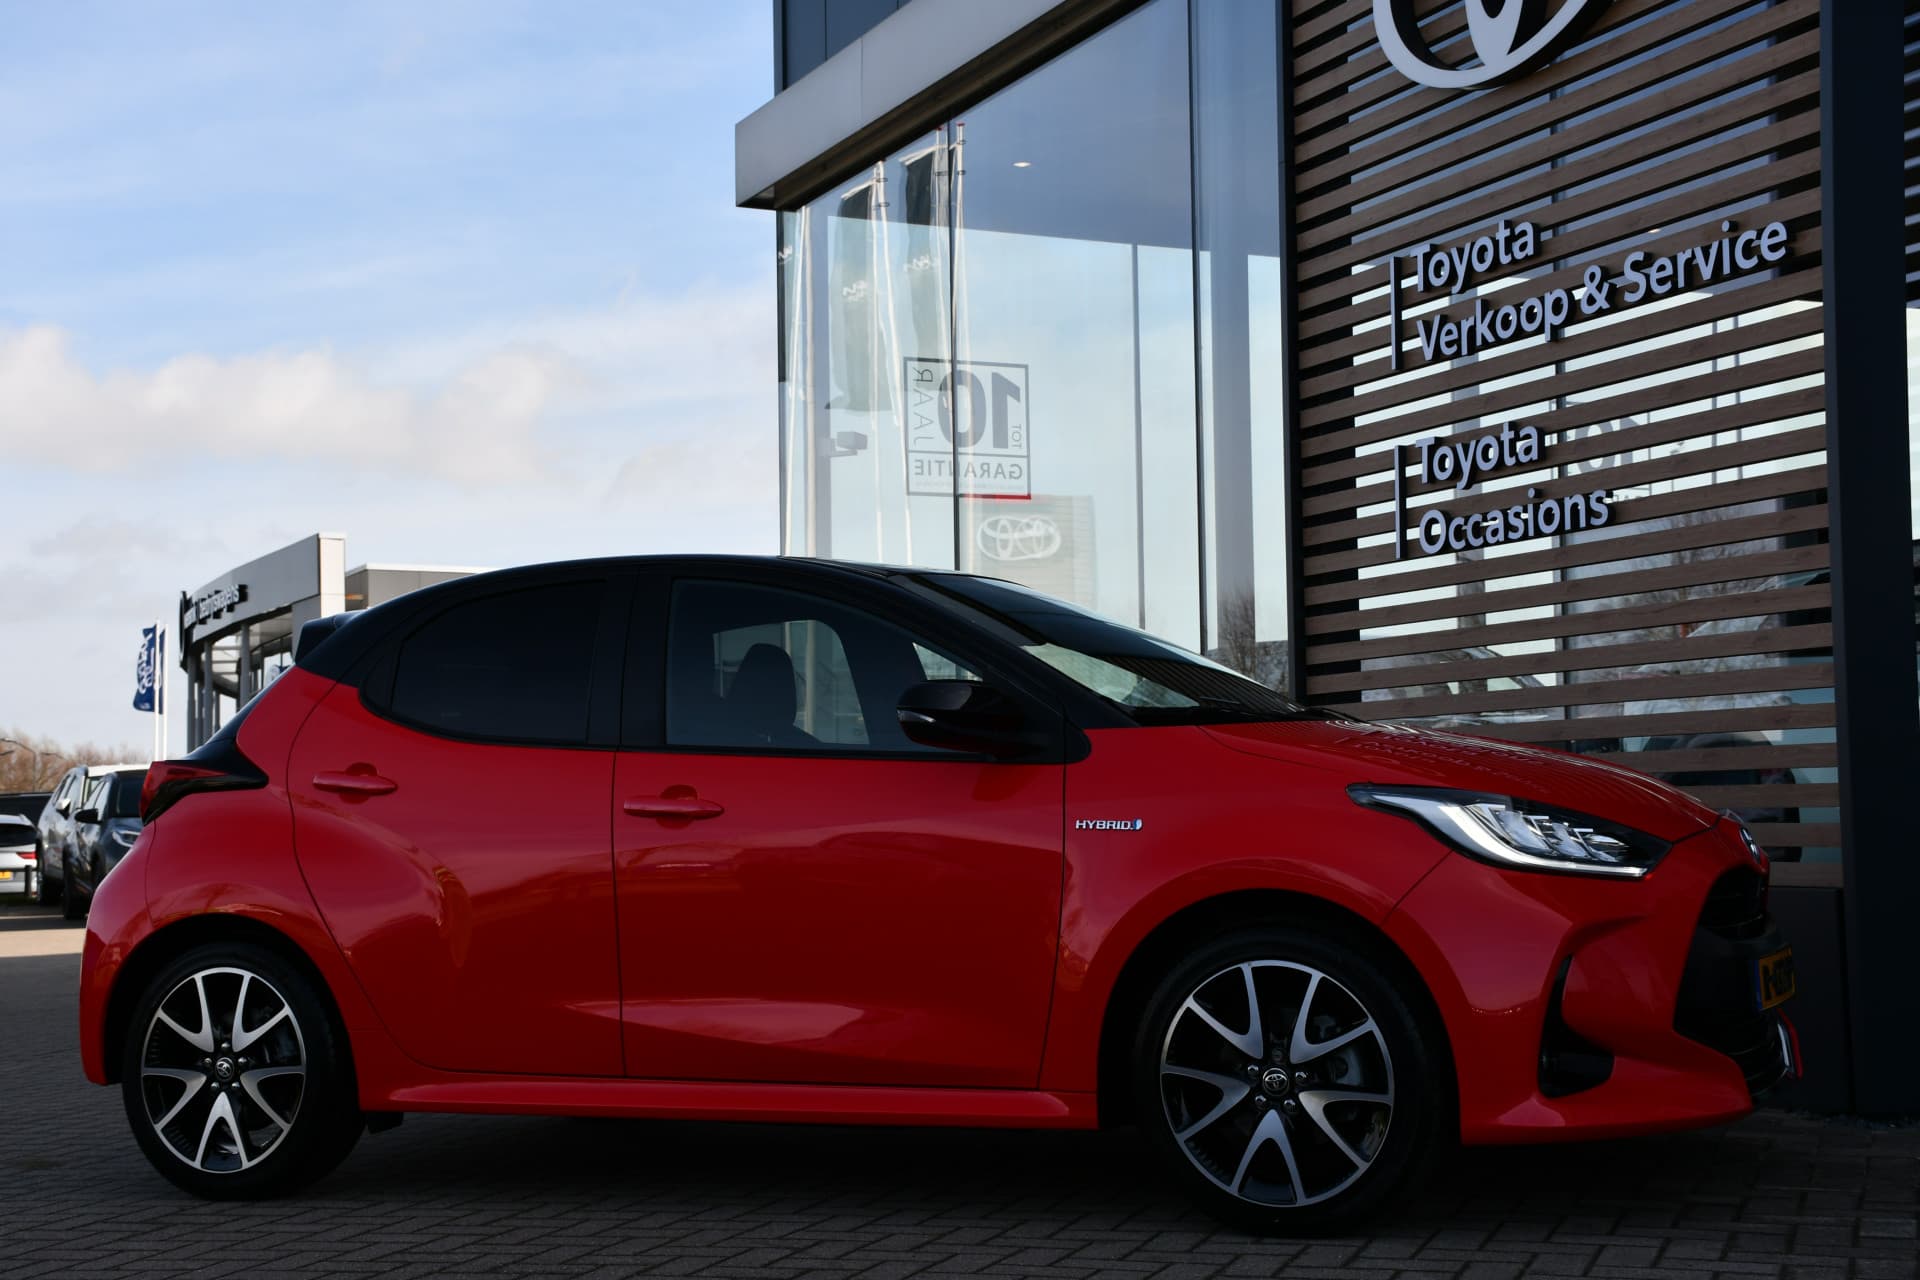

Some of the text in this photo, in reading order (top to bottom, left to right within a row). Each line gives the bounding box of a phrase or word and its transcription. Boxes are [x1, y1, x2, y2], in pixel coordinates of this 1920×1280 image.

[1411, 219, 1536, 294] Toyota
[1417, 221, 1788, 361] Verkoop & Service
[1416, 421, 1539, 488] Toyota
[1420, 488, 1610, 555] Occasions
[1075, 819, 1131, 830] HYBRID
